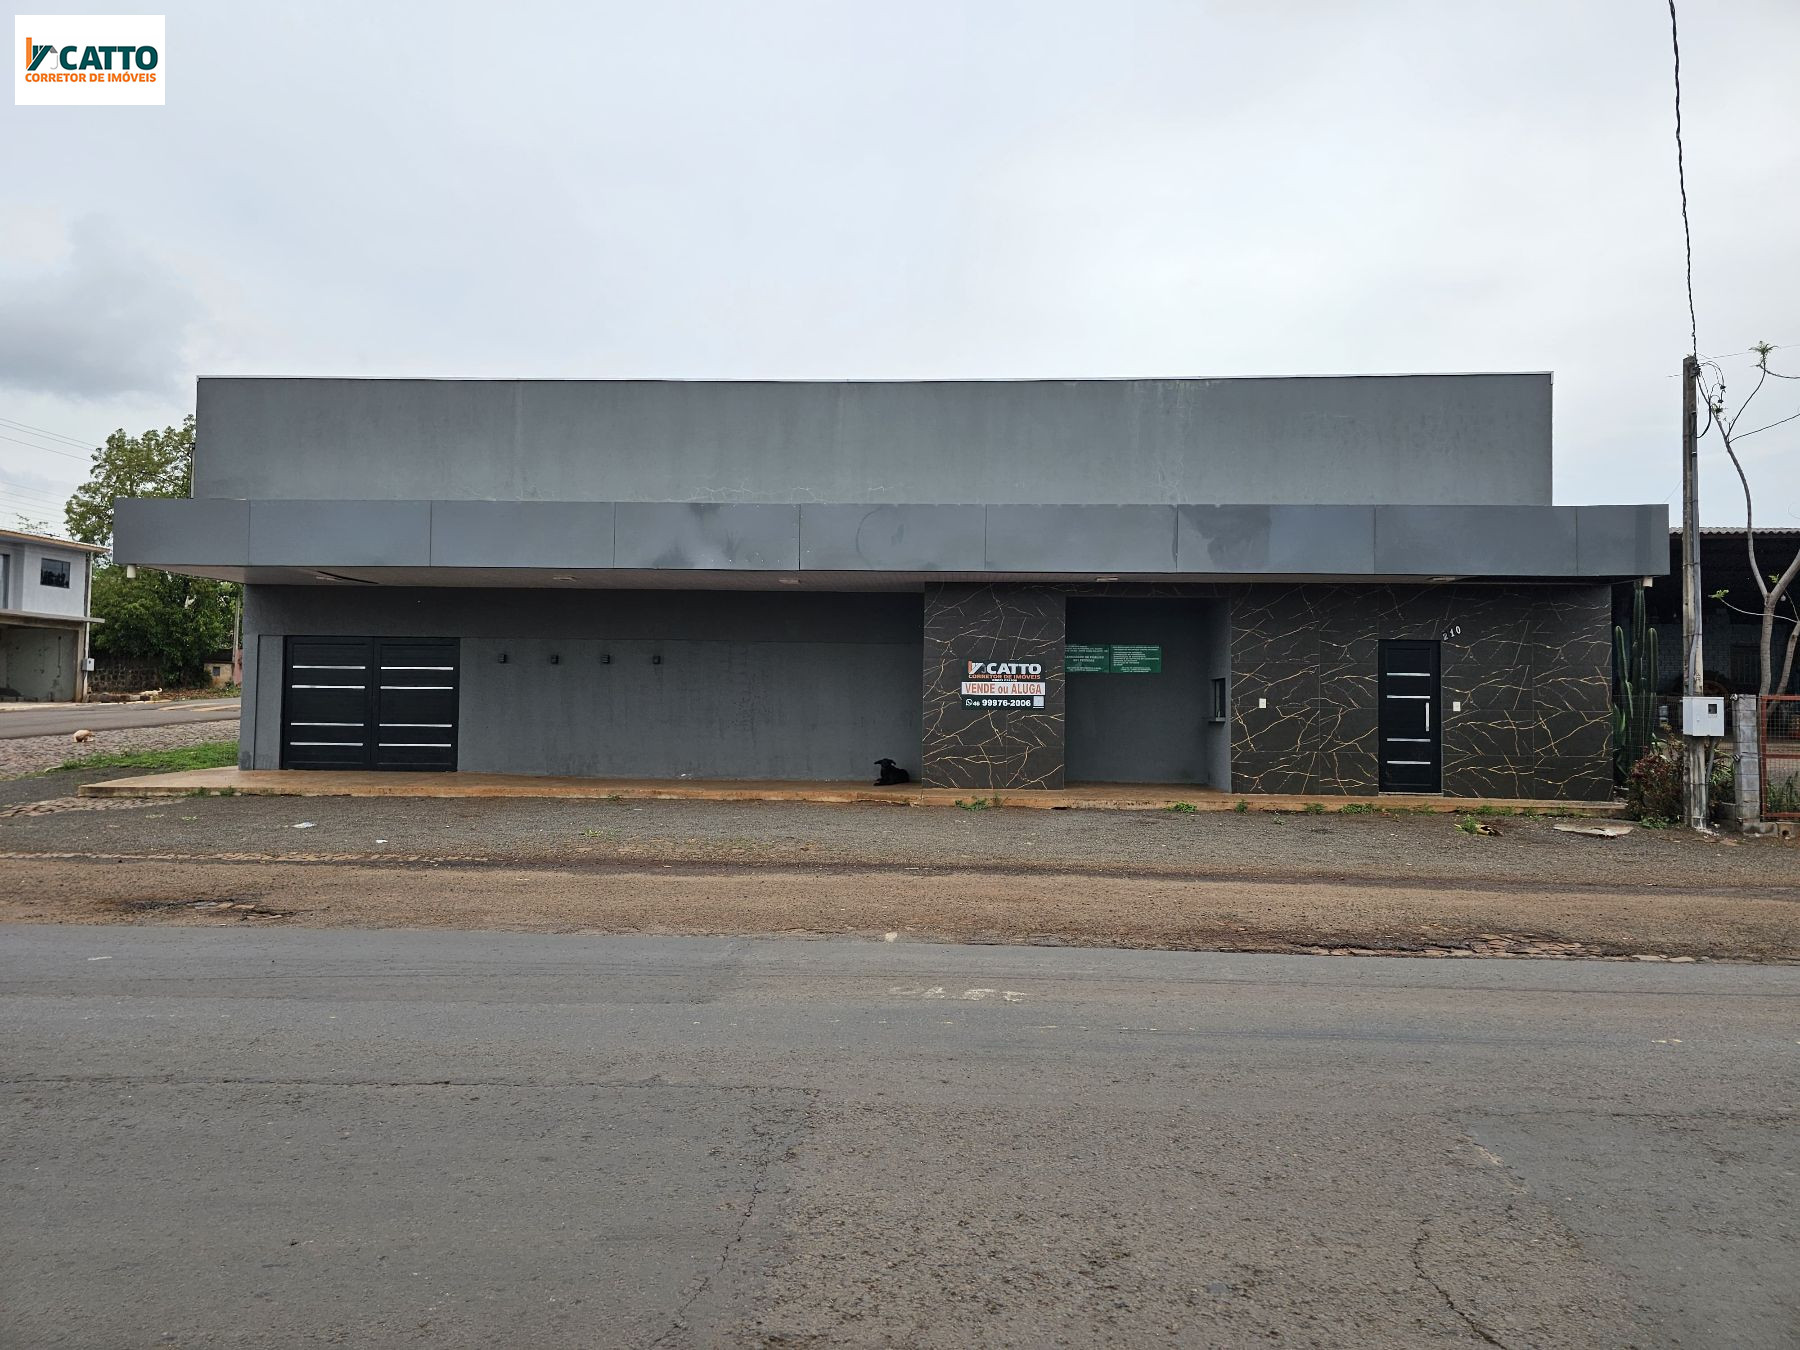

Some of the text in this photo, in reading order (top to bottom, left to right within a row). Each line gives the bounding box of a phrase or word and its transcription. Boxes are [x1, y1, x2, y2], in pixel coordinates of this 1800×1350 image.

[1442, 625, 1461, 641] 210
[986, 662, 1042, 674] CATTO
[965, 683, 1042, 695] VENDE ou ALUGA
